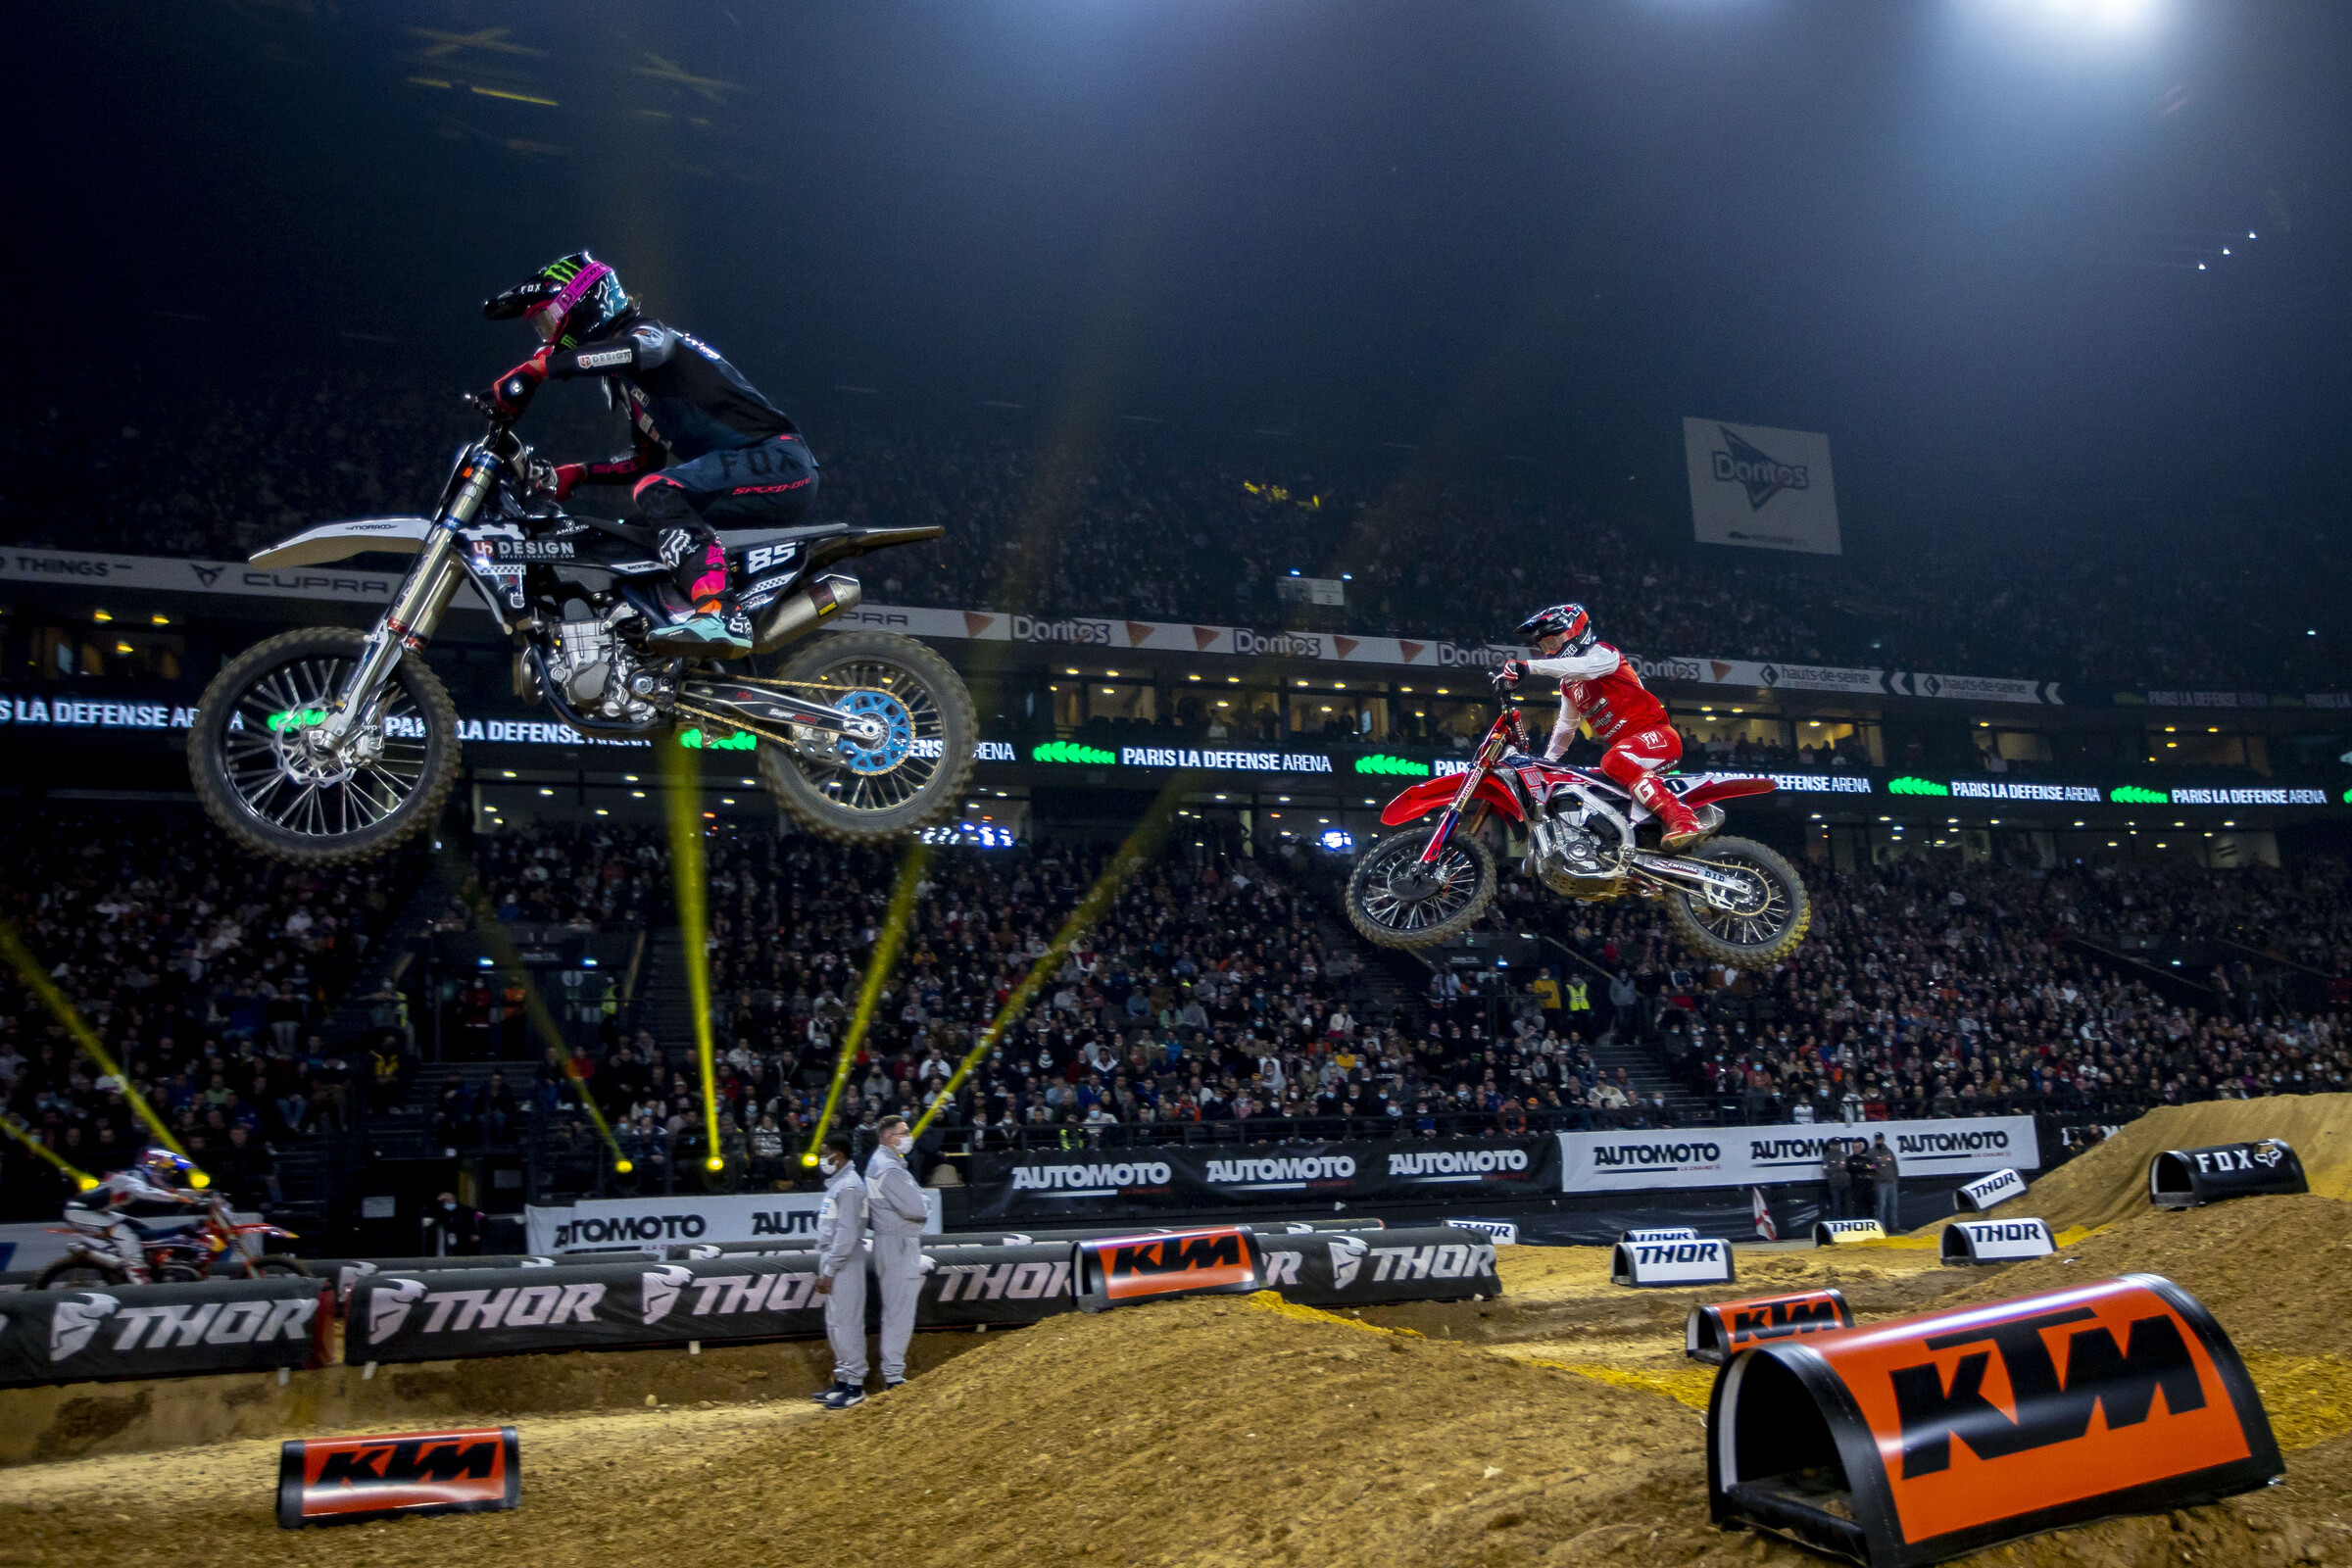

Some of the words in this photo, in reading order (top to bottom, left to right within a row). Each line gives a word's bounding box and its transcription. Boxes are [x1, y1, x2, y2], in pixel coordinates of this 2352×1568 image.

[1713, 452, 1809, 490] Doritos
[498, 541, 574, 555] DESIGN
[748, 542, 796, 574] 85
[17, 557, 109, 577] THINGS
[243, 572, 388, 594] CUPRA
[839, 609, 908, 627] PRA
[1011, 614, 1111, 646] Doritos
[1234, 627, 1321, 658] Doritos
[1438, 641, 1518, 668] Doritos
[14, 700, 50, 722] LA
[52, 701, 169, 727] DEFENSE
[457, 719, 485, 740] LA
[1642, 731, 1659, 745] FLY
[1122, 748, 1176, 766] PARIS
[1178, 750, 1201, 767] LA
[1202, 751, 1280, 770] DEFENSE
[1283, 754, 1332, 772] ARENA
[1832, 776, 1871, 794] ARENA
[1951, 781, 1990, 797] PARIS
[1992, 783, 2008, 798] LA
[2010, 784, 2064, 801] DEFENSE
[2065, 787, 2100, 802] ARENA
[2172, 789, 2211, 804] PARIS
[2213, 789, 2230, 804] LA
[2230, 789, 2287, 805] DEFENSE
[2288, 789, 2328, 805] ARENA
[1750, 1136, 1869, 1159] AUTOMTO
[1896, 1130, 2008, 1153] AUTOMOTO
[1389, 1150, 1528, 1175] AUTOMOTO
[1593, 1143, 1720, 1166] AUTOMOTO
[2194, 1149, 2254, 1174] FOX
[1012, 1162, 1171, 1190] AUTOMOTO
[1206, 1156, 1355, 1183] AUTOMOTO
[1971, 1172, 2016, 1199] THOR
[1831, 1221, 1878, 1233] THOR
[1970, 1223, 2041, 1243] THOR
[1110, 1235, 1242, 1277] KTM
[1370, 1244, 1495, 1283] THOR
[1636, 1243, 1719, 1265] THOR
[938, 1261, 1072, 1302] THOR
[421, 1284, 607, 1334] THOR
[1735, 1298, 1837, 1344] KTM
[113, 1298, 318, 1350] THOR
[1889, 1306, 2207, 1481] KTM
[312, 1437, 500, 1490] KTM
